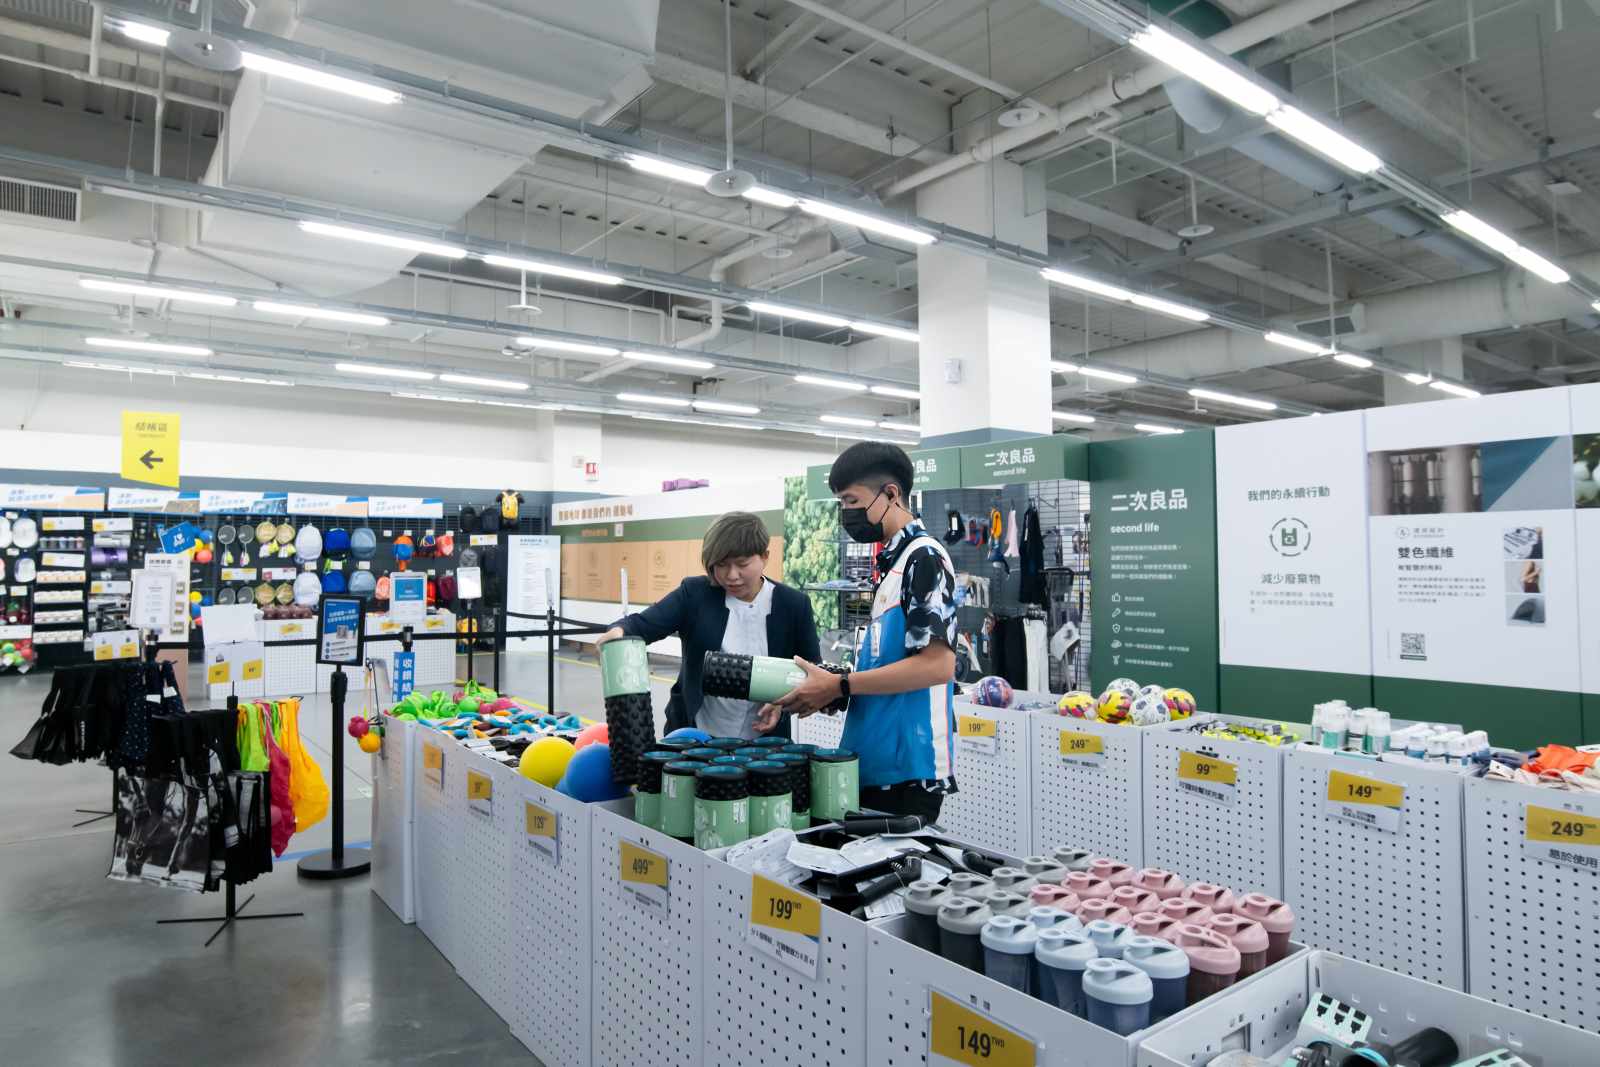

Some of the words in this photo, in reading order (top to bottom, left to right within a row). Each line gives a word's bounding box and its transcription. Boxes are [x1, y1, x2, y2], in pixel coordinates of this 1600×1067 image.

[984, 447, 1036, 466] 二次良品
[1110, 488, 1188, 511] 二次良品
[1247, 486, 1331, 503] 我們的永續行動
[1110, 523, 1143, 534] second
[1144, 522, 1160, 533] life
[1398, 546, 1455, 559] 雙色纖維
[1070, 738, 1085, 750] 249
[1196, 763, 1210, 775] 99
[1347, 784, 1372, 798] 149
[1551, 820, 1584, 837] 249
[632, 857, 649, 875] 499
[769, 898, 793, 920] 199
[957, 1026, 991, 1058] 149
